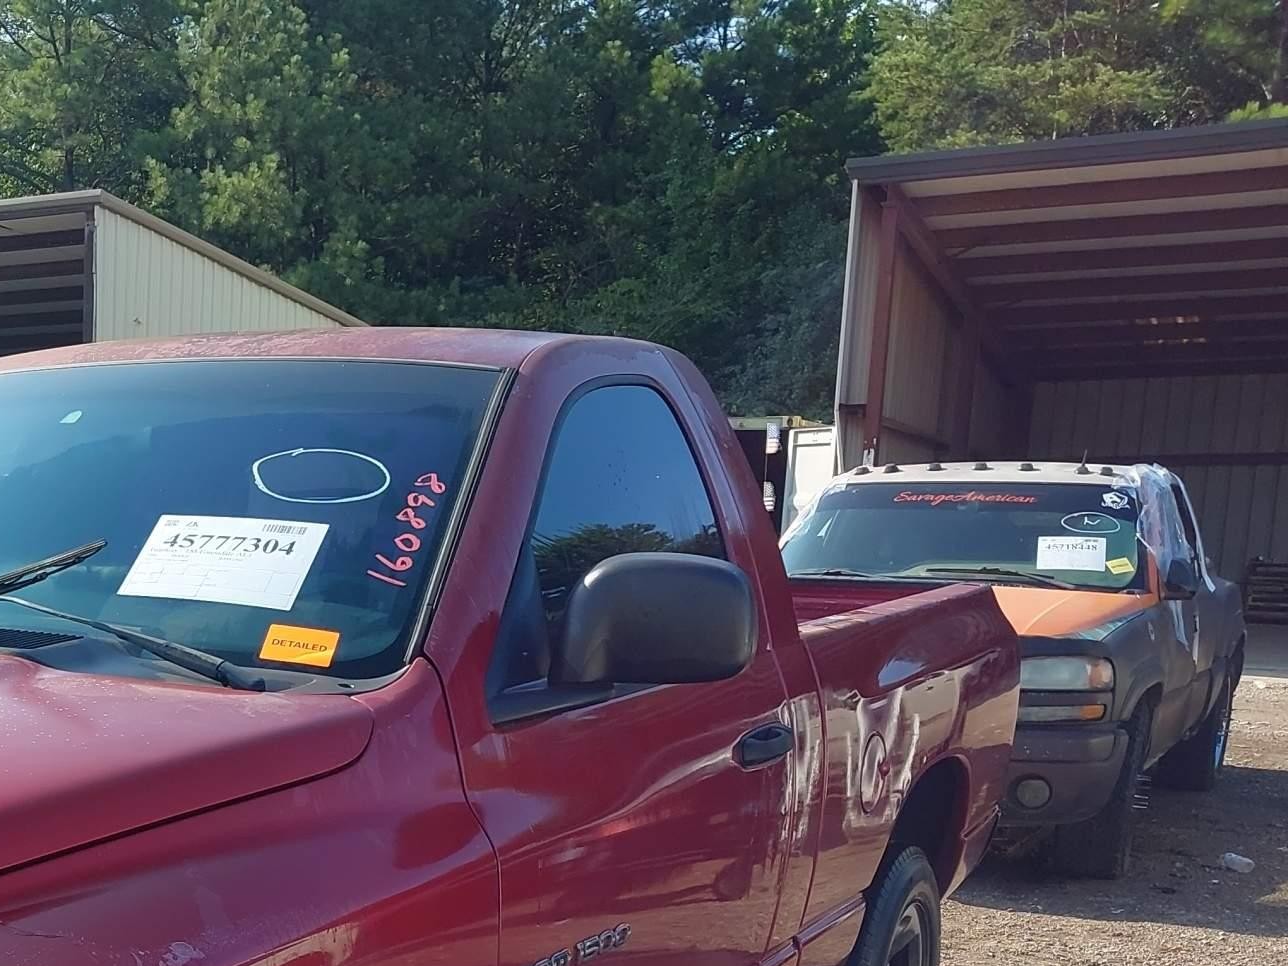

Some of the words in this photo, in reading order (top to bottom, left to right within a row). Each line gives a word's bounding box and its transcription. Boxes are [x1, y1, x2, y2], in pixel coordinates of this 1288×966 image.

[366, 472, 446, 587] 160898
[163, 532, 297, 557] 45777304
[271, 638, 328, 653] DETAILED
